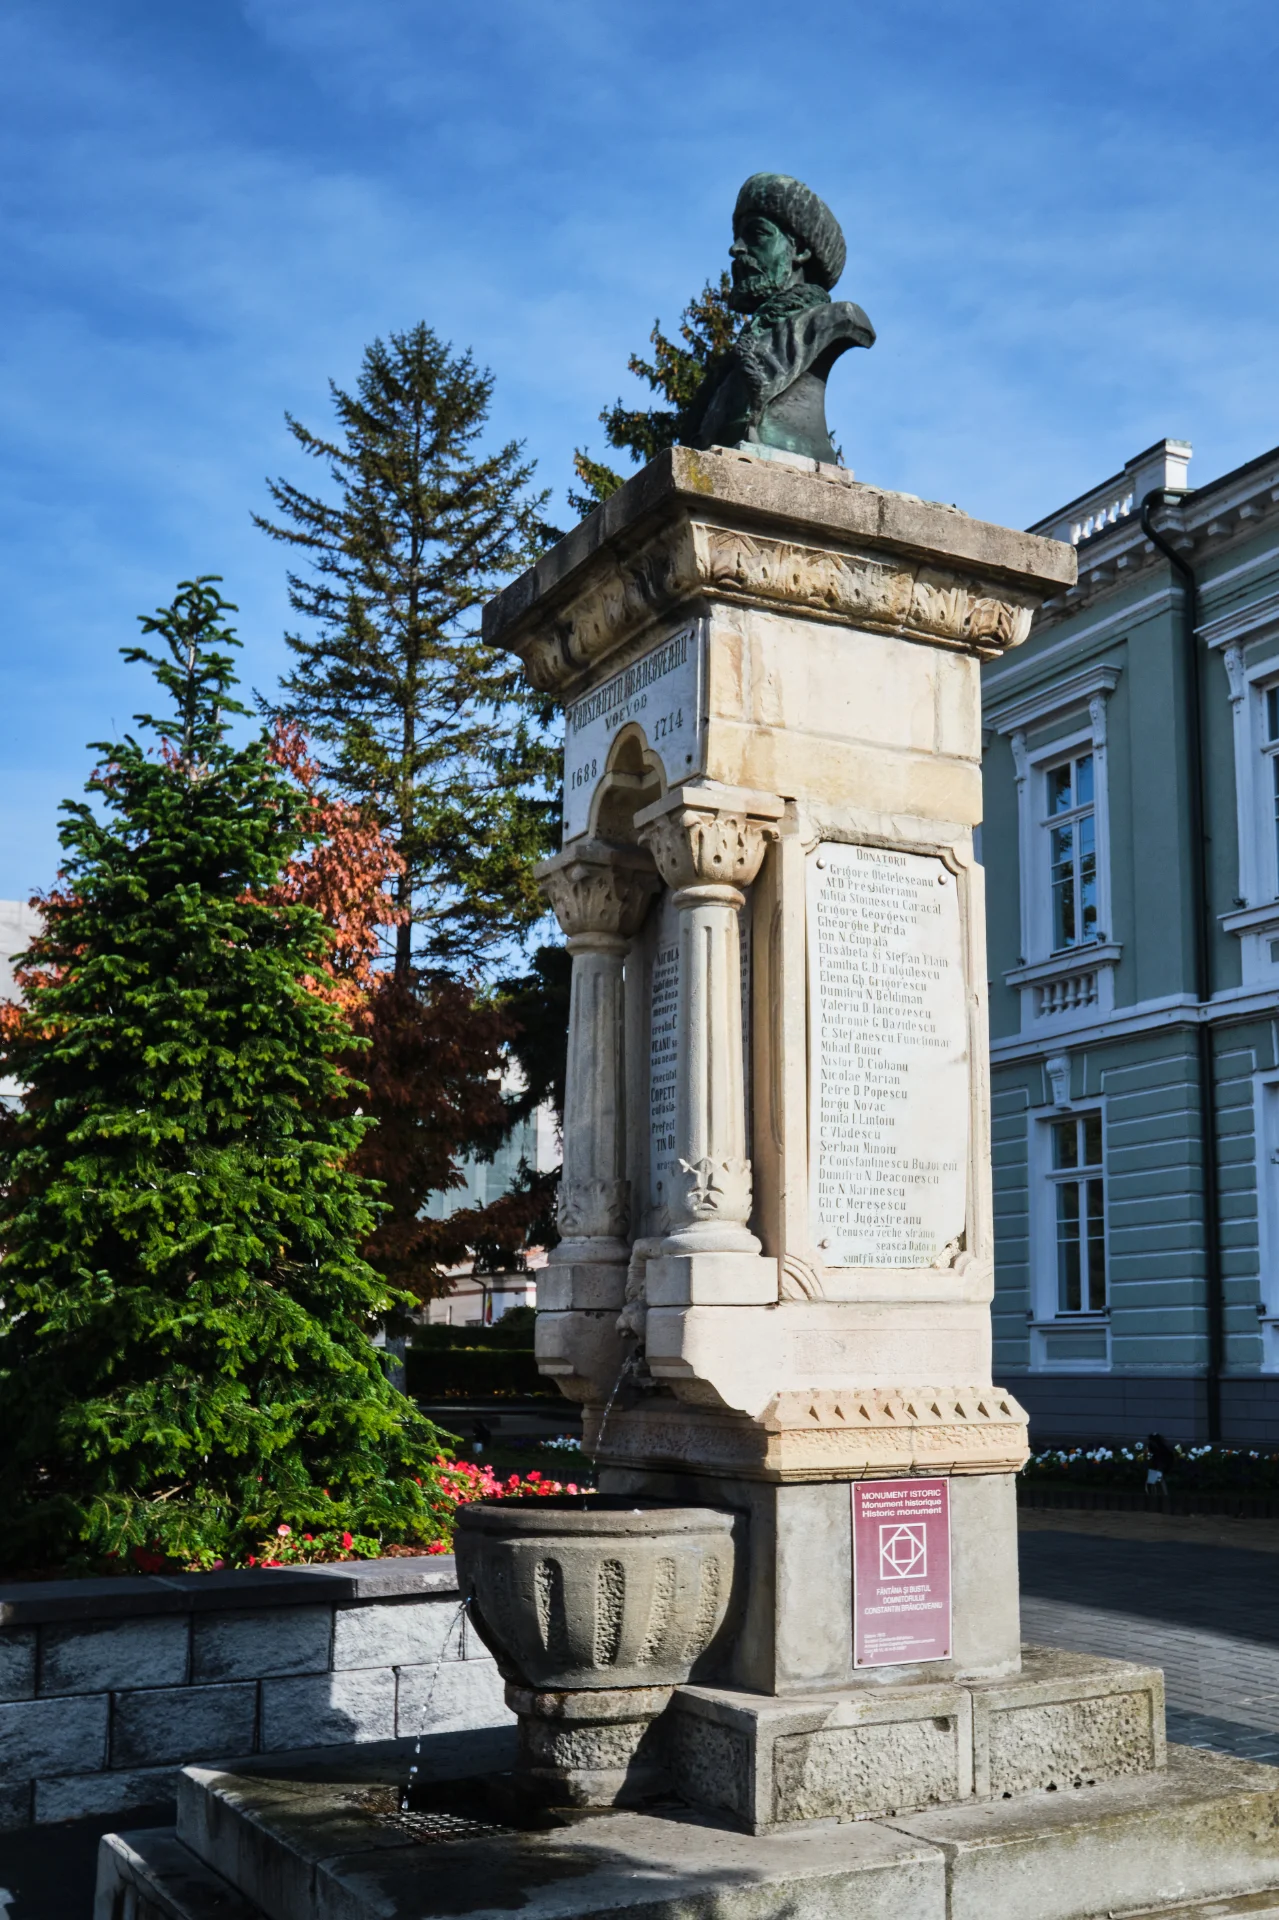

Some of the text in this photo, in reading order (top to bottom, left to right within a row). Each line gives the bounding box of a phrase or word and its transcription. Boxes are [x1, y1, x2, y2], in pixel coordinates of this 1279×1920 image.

[605, 694, 647, 731] VOEVOD
[572, 759, 597, 790] 1688
[857, 849, 906, 866] DONATORII
[830, 864, 868, 880] Grigore
[818, 903, 917, 924] Grigore Georgescu
[818, 916, 869, 932] Gheorghe
[819, 930, 834, 941] Ion
[820, 957, 858, 971] Familia
[820, 971, 848, 983] Elena
[869, 976, 927, 991] Grigorescu
[821, 985, 862, 998] Dumitru
[877, 991, 922, 1004] Beldiman
[821, 999, 858, 1012] Valeriu
[873, 1004, 931, 1018] Iancovescu
[821, 1041, 850, 1053] Mihail
[868, 1059, 908, 1071] Ciobanu
[821, 1069, 900, 1084] Nicolae Marian
[821, 1083, 849, 1095] Petre
[864, 1086, 907, 1100] Popescu
[821, 1097, 885, 1112] Iorgu Novac
[830, 1156, 908, 1168] Constantinescu
[819, 1168, 861, 1180] Dumitru
[877, 1171, 938, 1184] Deaconescu
[850, 1185, 905, 1196] Marinescu
[862, 1491, 908, 1500] MONUMENT
[862, 1499, 941, 1508] Monument historique
[897, 1507, 941, 1516] monument
[865, 1605, 900, 1614] CONSTANTIN
